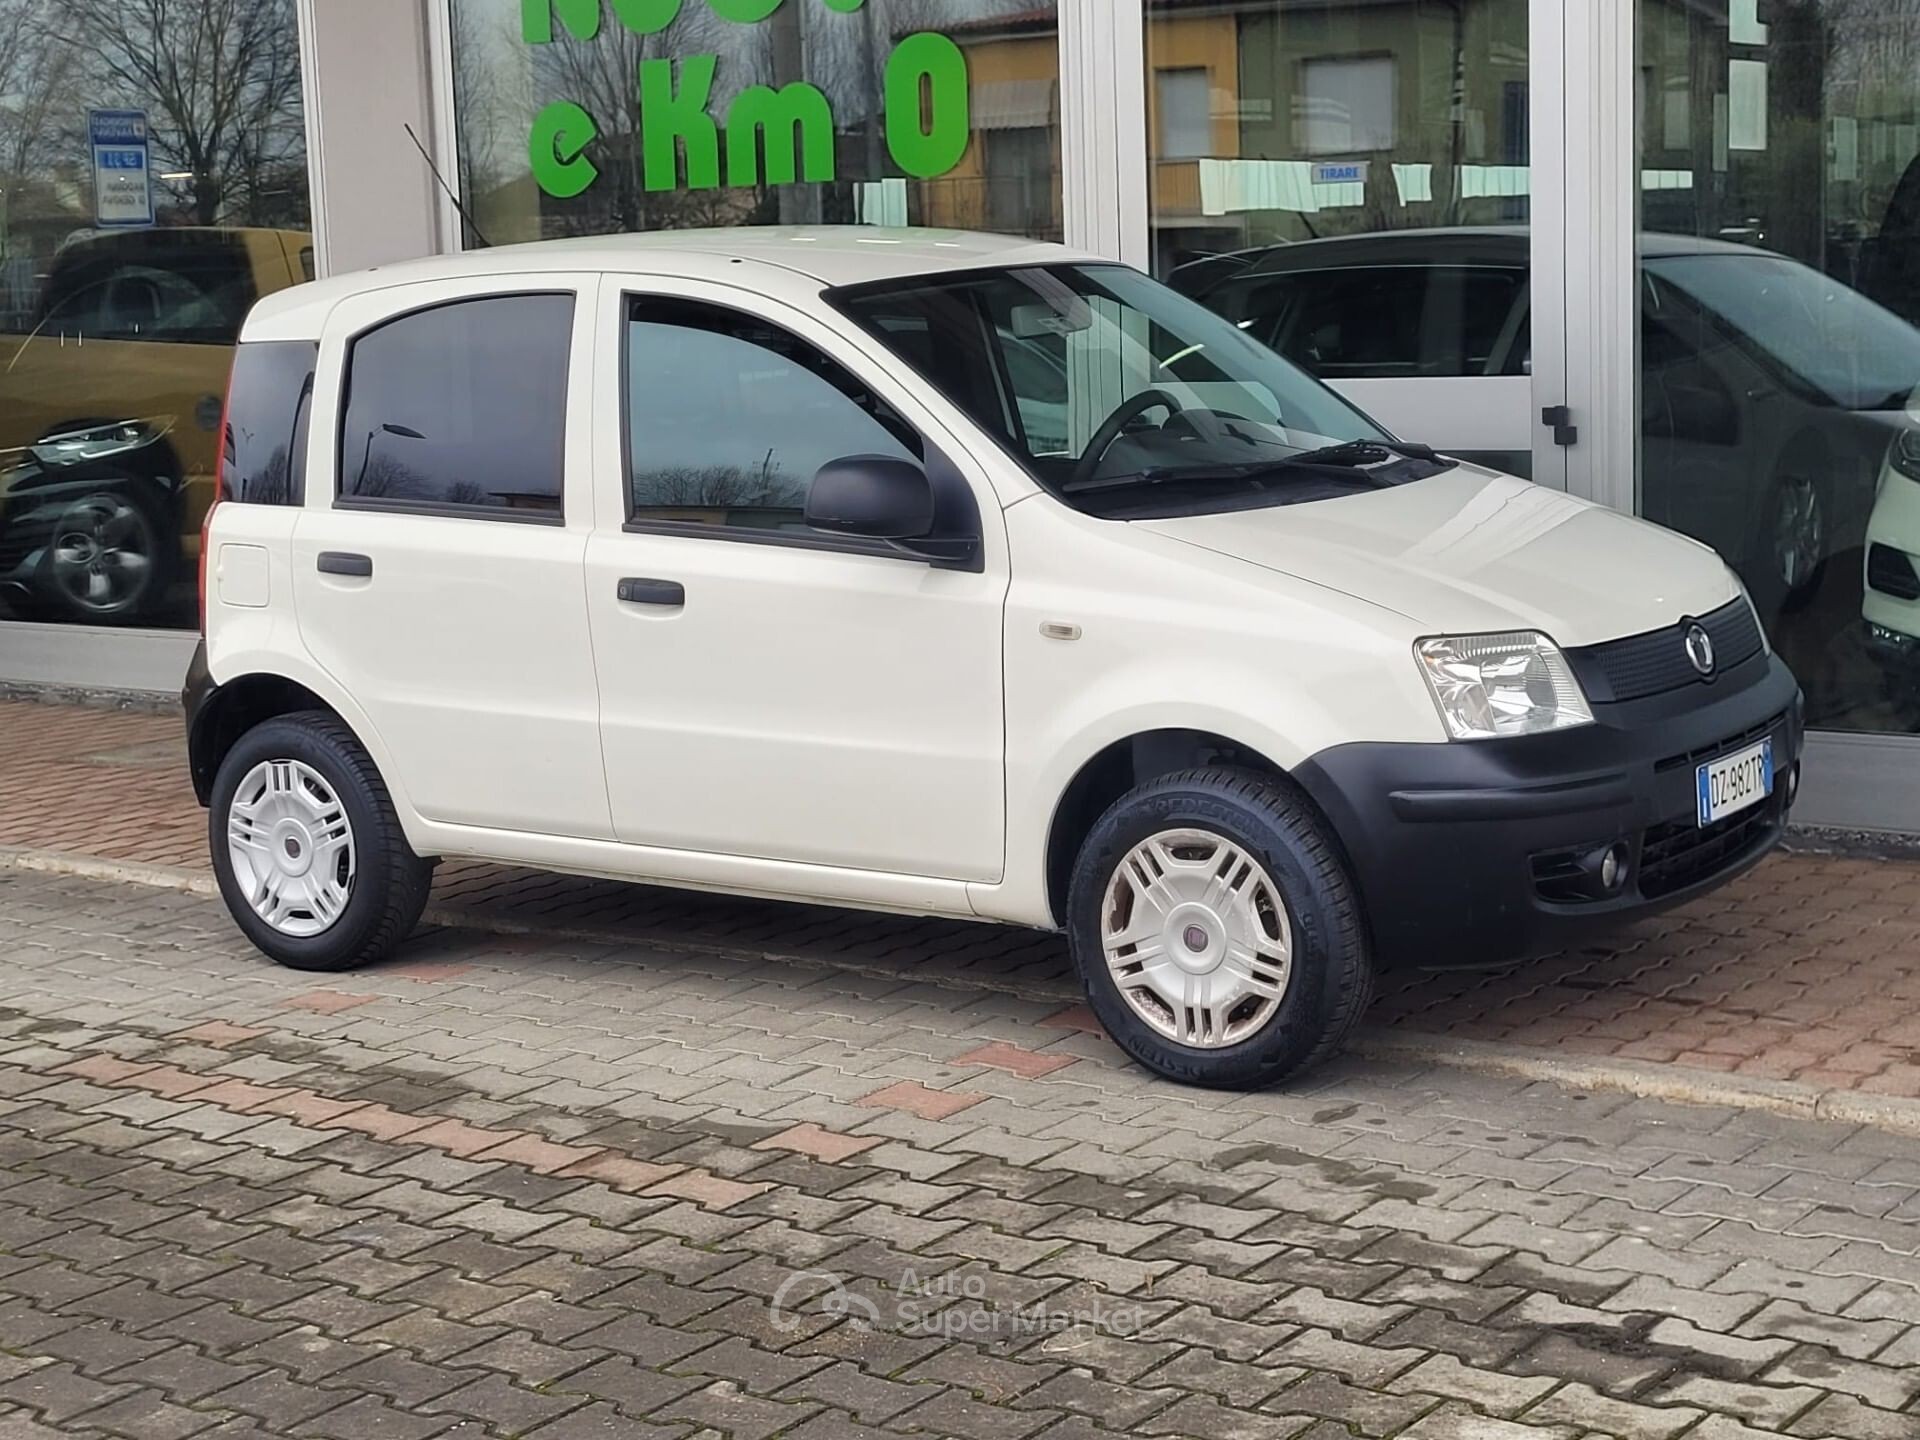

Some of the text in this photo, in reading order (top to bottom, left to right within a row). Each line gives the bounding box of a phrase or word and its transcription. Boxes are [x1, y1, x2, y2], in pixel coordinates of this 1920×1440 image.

[529, 102, 599, 198] e
[640, 54, 835, 192] Km
[1319, 166, 1358, 179] TIRARE
